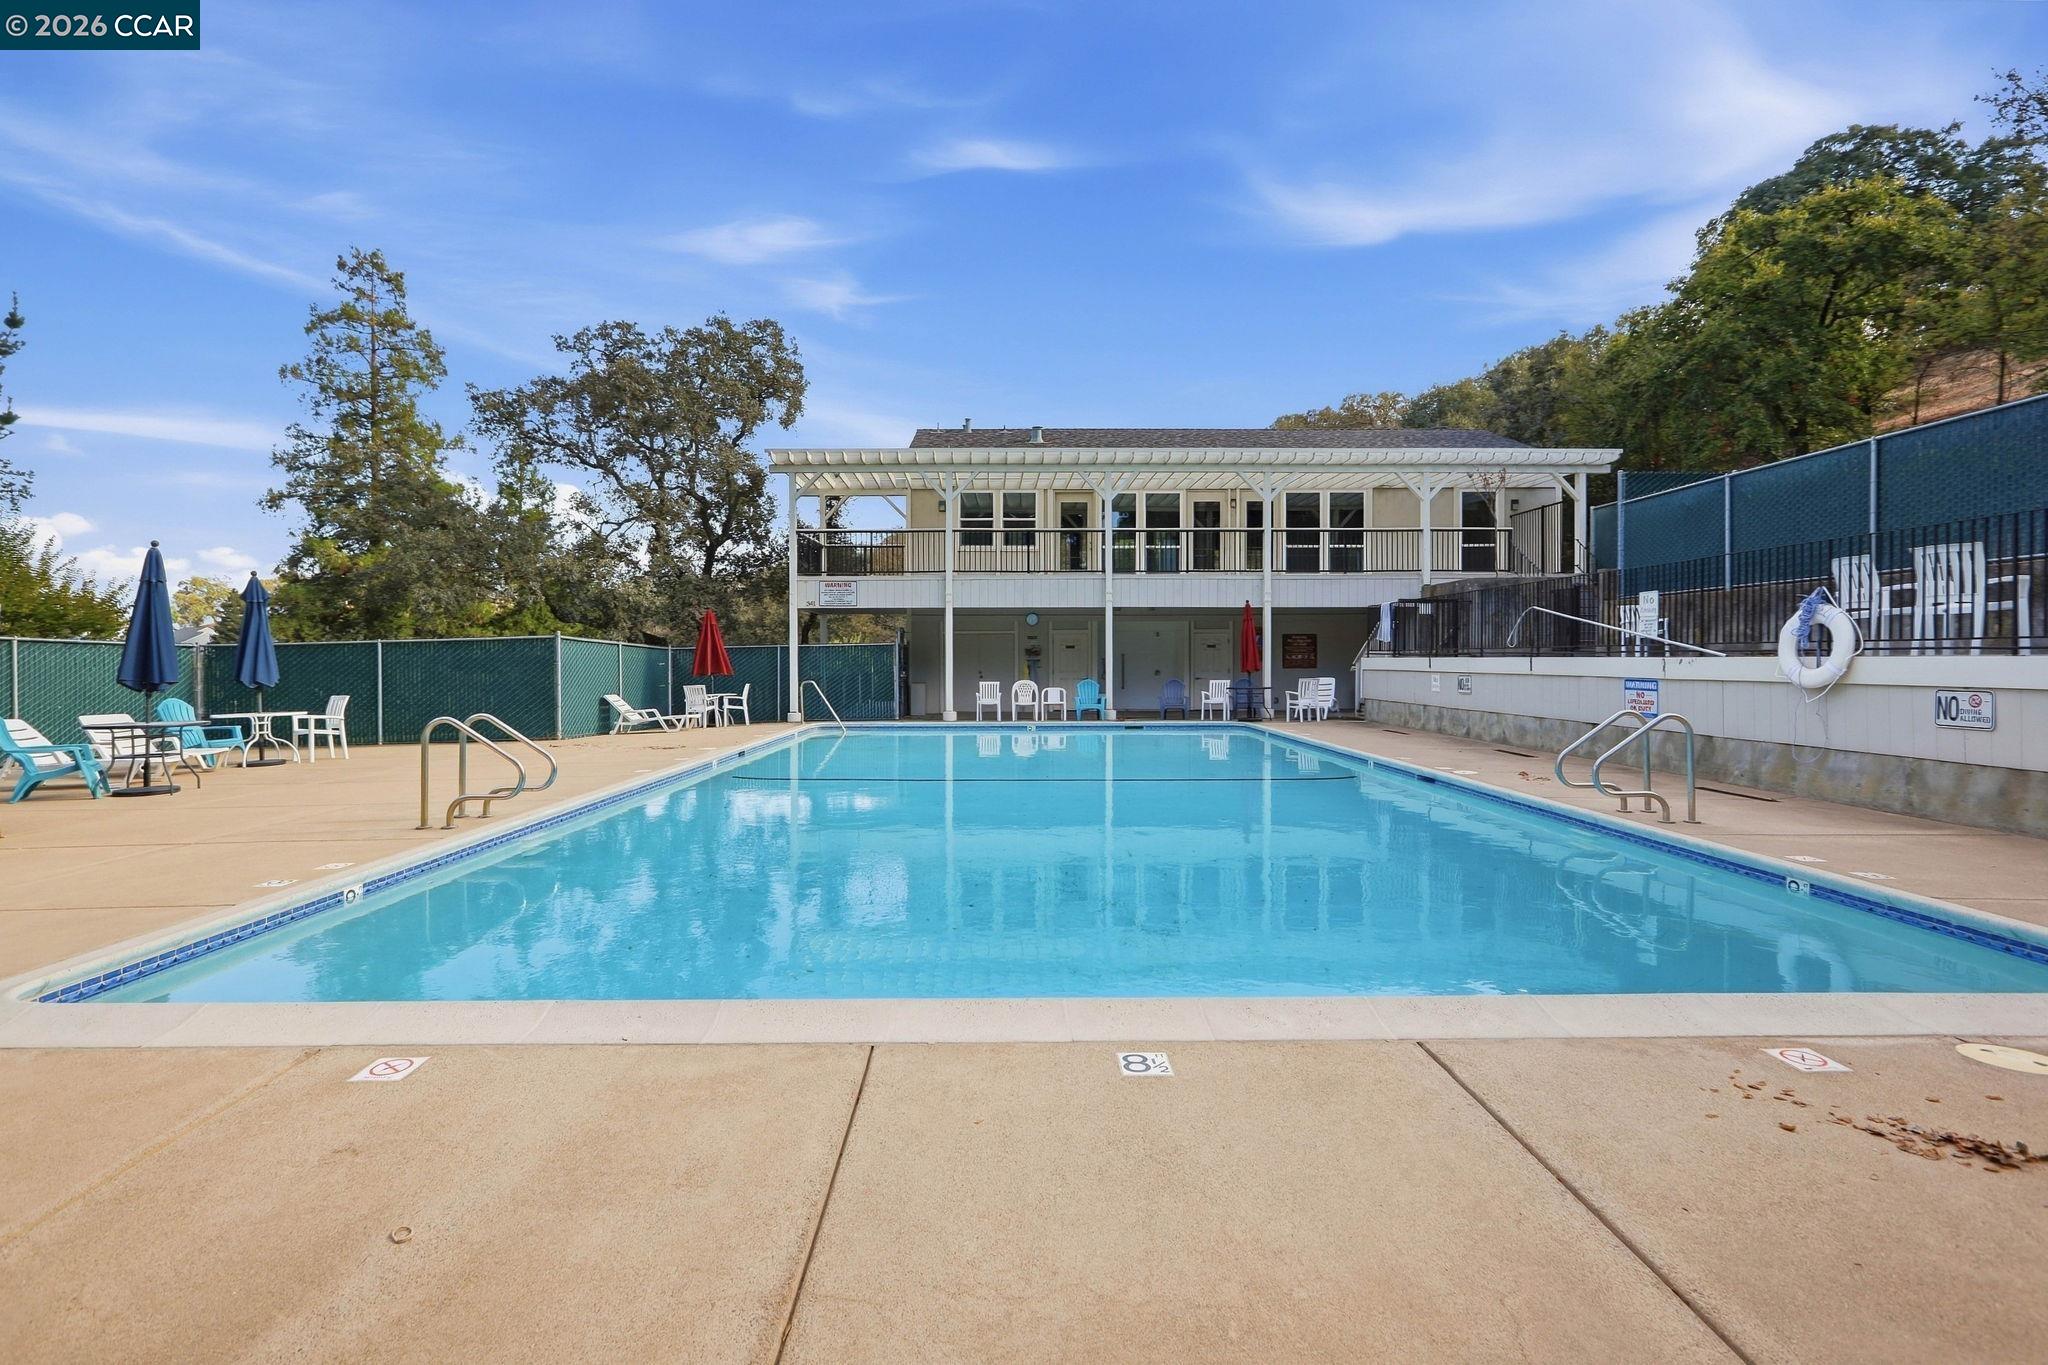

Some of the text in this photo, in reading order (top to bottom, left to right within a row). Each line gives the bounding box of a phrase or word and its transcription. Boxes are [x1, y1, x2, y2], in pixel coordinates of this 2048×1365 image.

[1625, 681, 1657, 690] WARNING
[1937, 695, 1960, 721] NO
[1960, 708, 1982, 716] DIVING
[1960, 716, 1991, 724] ALLOWED
[1122, 1054, 1151, 1073] 8
